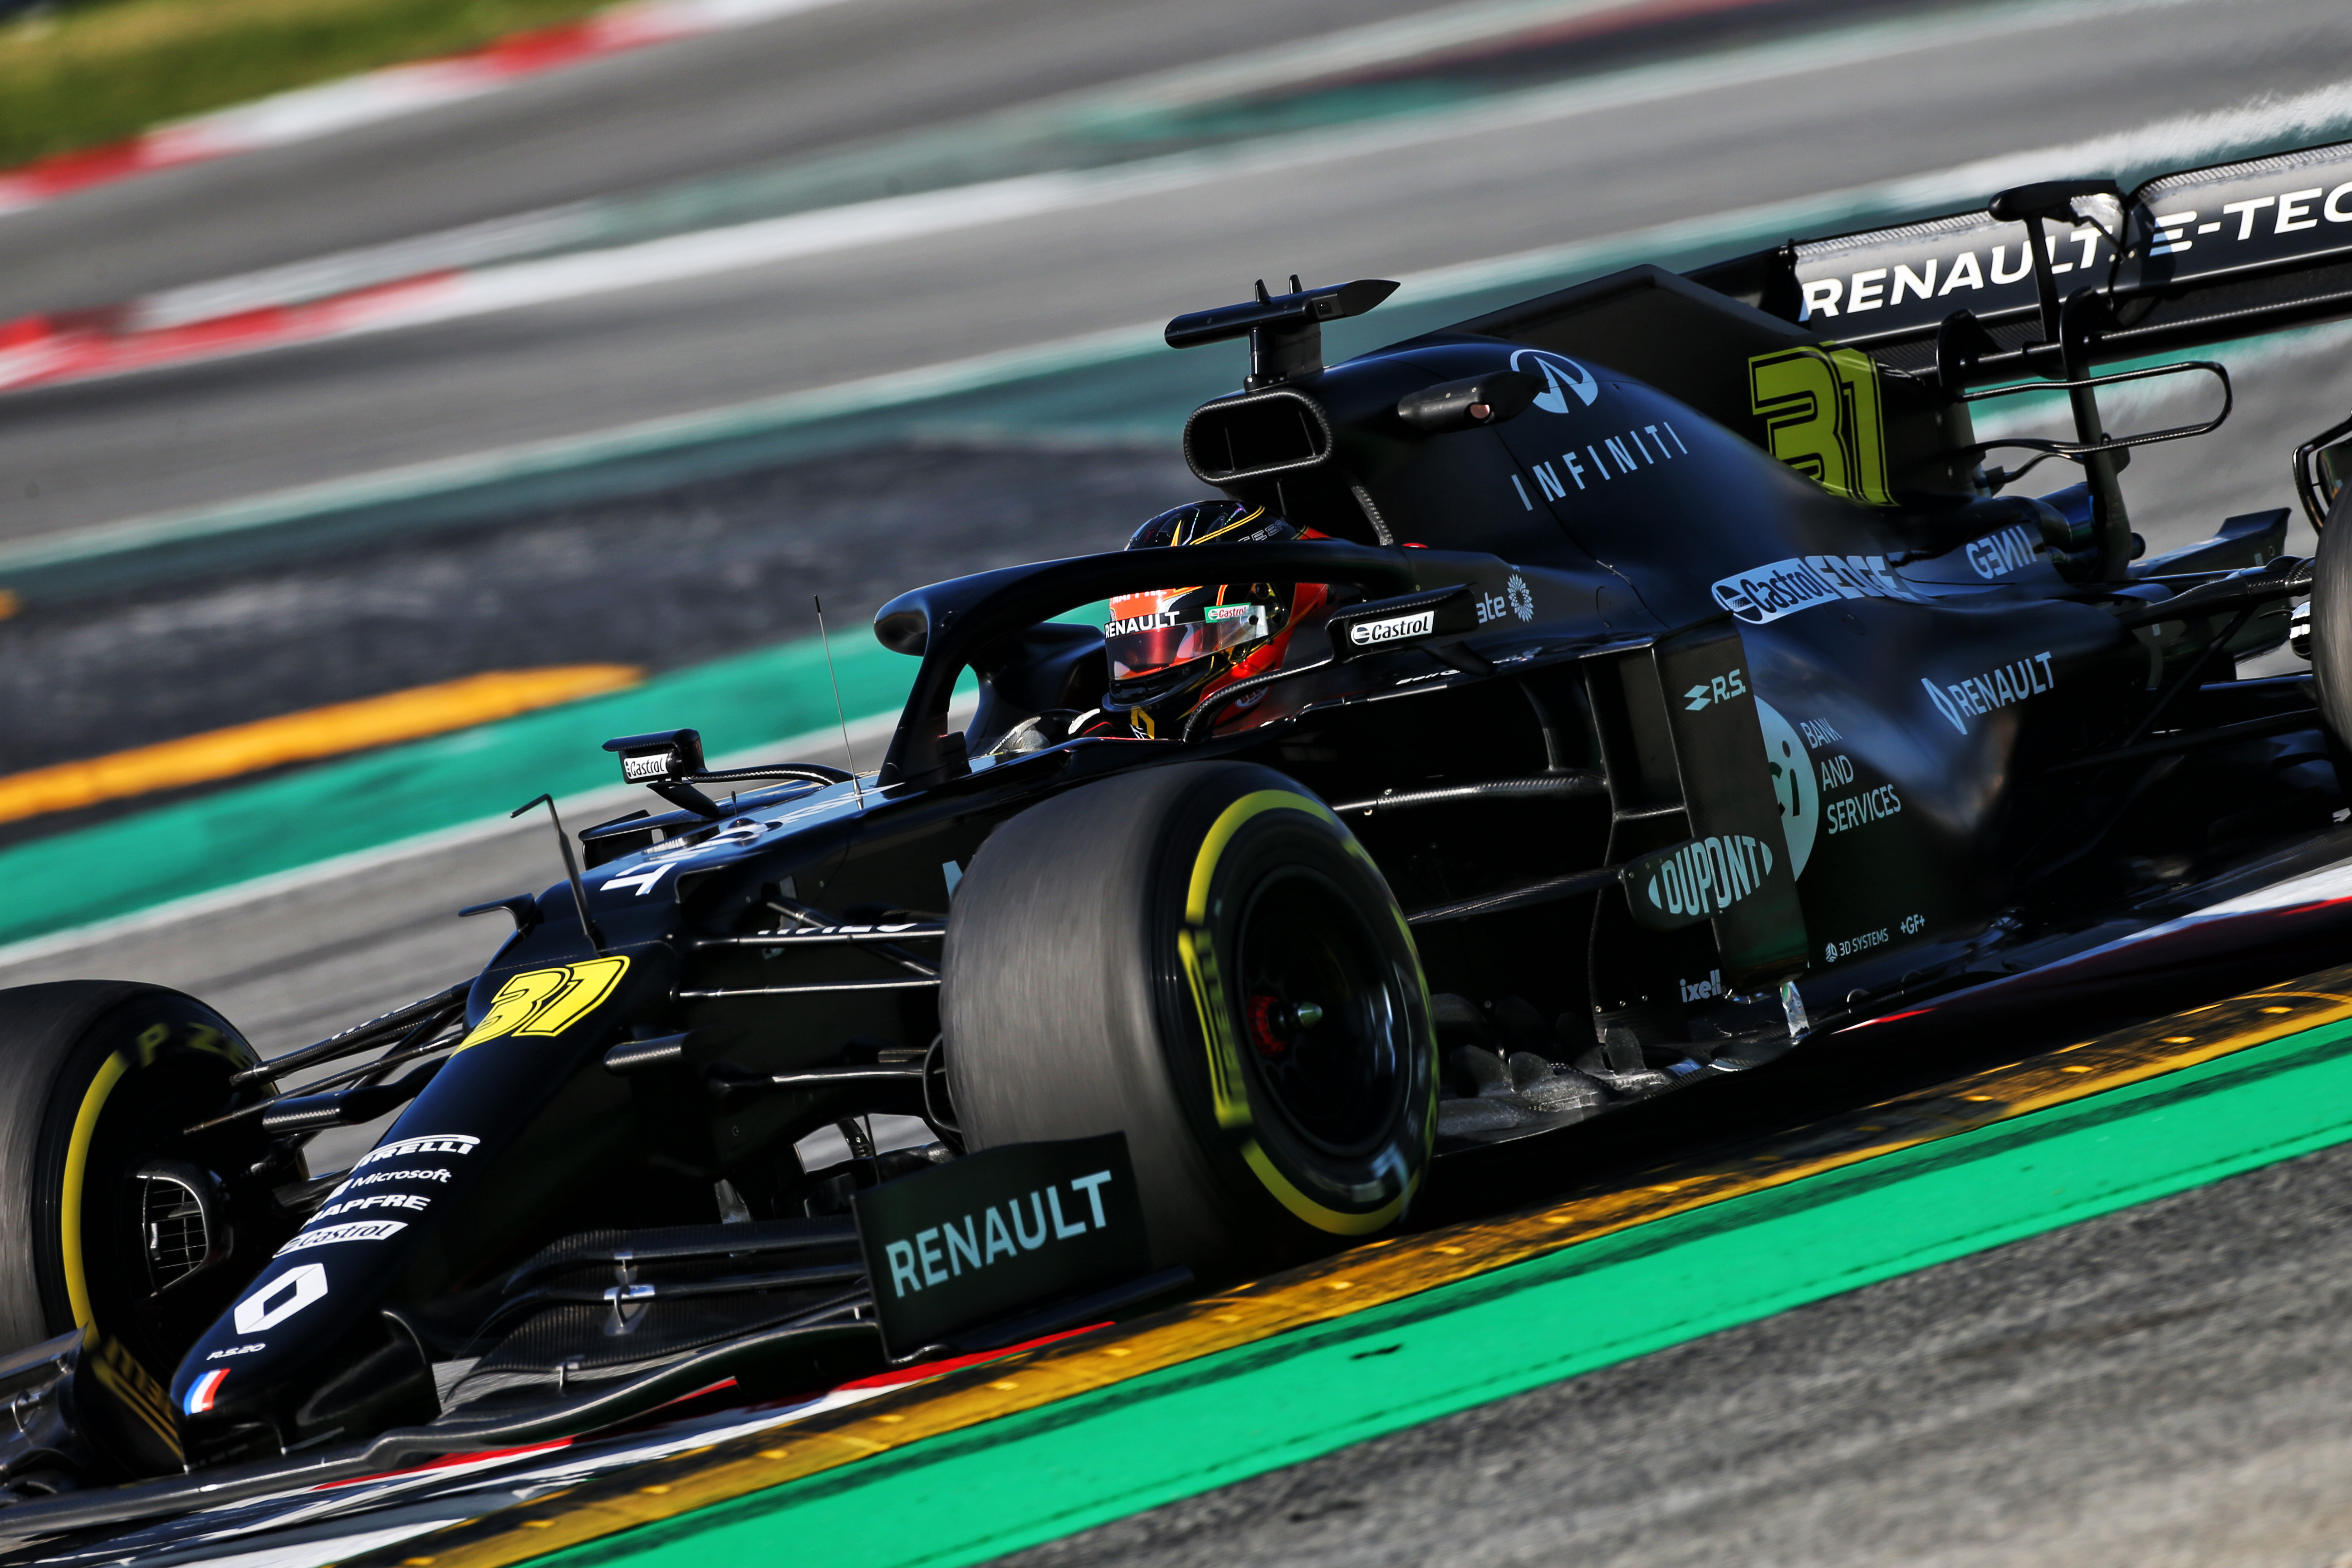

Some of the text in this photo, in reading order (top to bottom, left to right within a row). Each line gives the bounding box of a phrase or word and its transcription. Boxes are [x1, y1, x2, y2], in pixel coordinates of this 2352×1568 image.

[1798, 225, 2113, 322] RENAULT
[1748, 340, 1901, 506] 31
[1511, 421, 1688, 511] INFINITI
[1740, 555, 1919, 613] Castrol EDGE
[1105, 610, 1180, 639] RENAULT
[1372, 616, 1429, 641] Castrol
[1947, 651, 2054, 717] RENAULT
[1800, 717, 1843, 749] BANK
[631, 755, 666, 777] Castrol
[1821, 755, 1854, 791] AND
[1827, 784, 1901, 834] SERVICES
[1661, 835, 1760, 916] DUPONT
[1839, 928, 1889, 956] 3D SYSTEMS
[1680, 969, 1722, 1003] ixell
[446, 955, 630, 1063] 31
[351, 1169, 451, 1189] Microsoft
[299, 1224, 394, 1247] Castrol
[885, 1171, 1112, 1298] RENAULT
